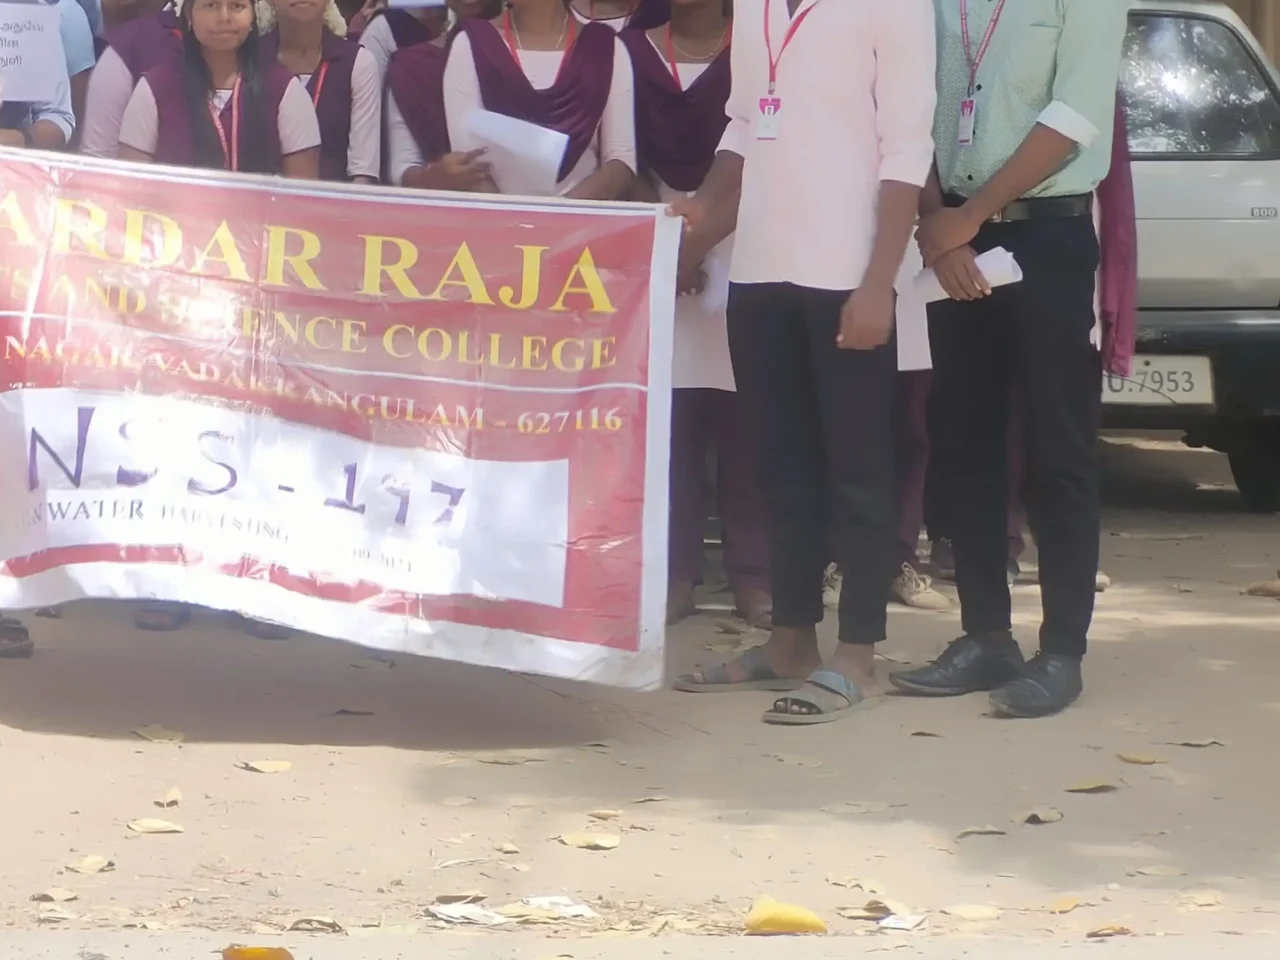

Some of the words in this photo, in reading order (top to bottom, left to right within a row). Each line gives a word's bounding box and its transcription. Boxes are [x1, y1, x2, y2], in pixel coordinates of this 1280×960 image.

[356, 234, 618, 314] RAJA
[49, 274, 147, 315] AND
[160, 286, 367, 354] ENCE
[383, 324, 617, 373] COLLEGE
[517, 406, 622, 435] 627116
